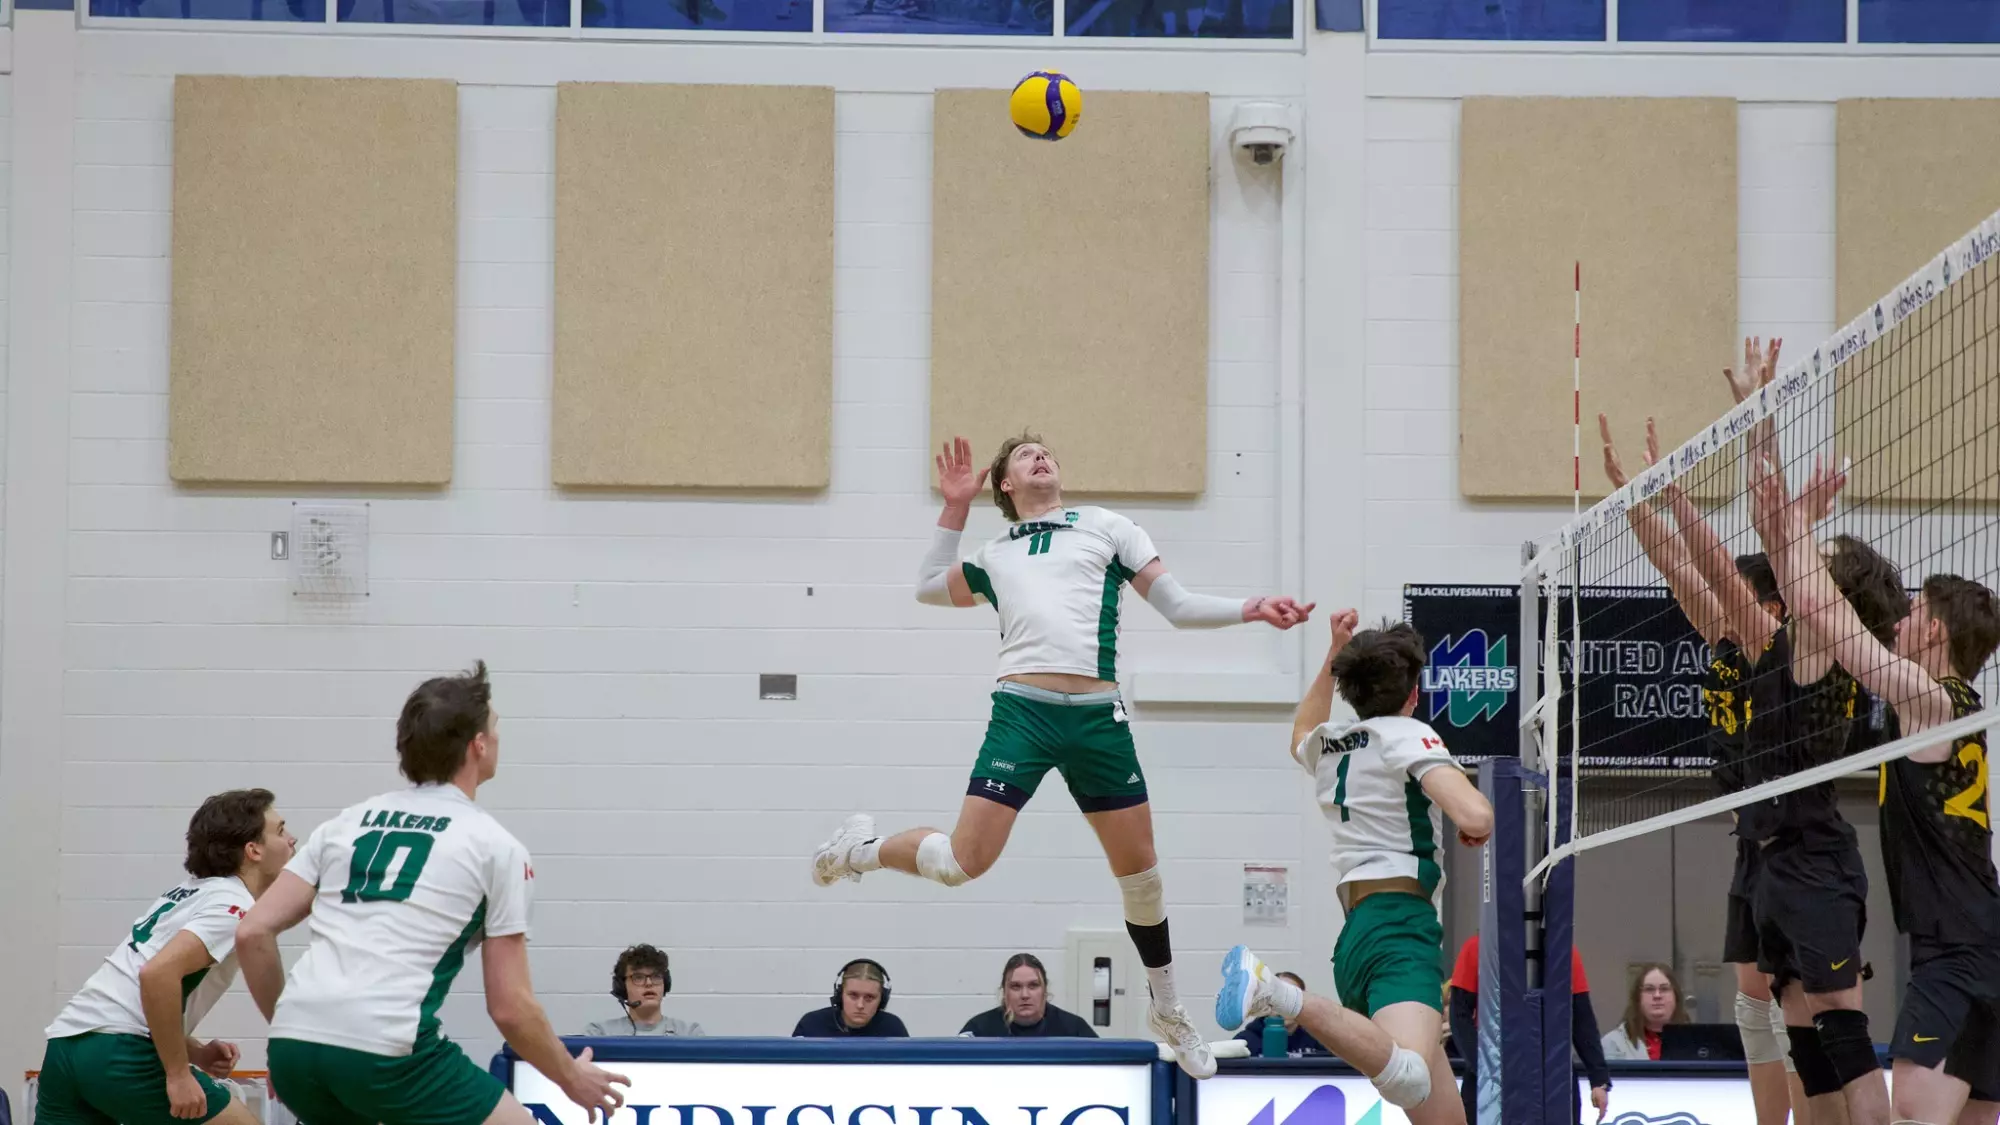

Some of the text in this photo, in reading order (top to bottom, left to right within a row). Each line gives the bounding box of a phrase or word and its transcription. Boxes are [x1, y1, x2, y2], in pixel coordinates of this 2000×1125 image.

[1028, 531, 1053, 556] 11
[1422, 666, 1517, 692] LAKERS
[1614, 683, 1709, 718] RACI
[1333, 753, 1351, 823] 1
[360, 809, 452, 833] LAKERS
[340, 829, 436, 904] 10
[127, 901, 177, 954] 4
